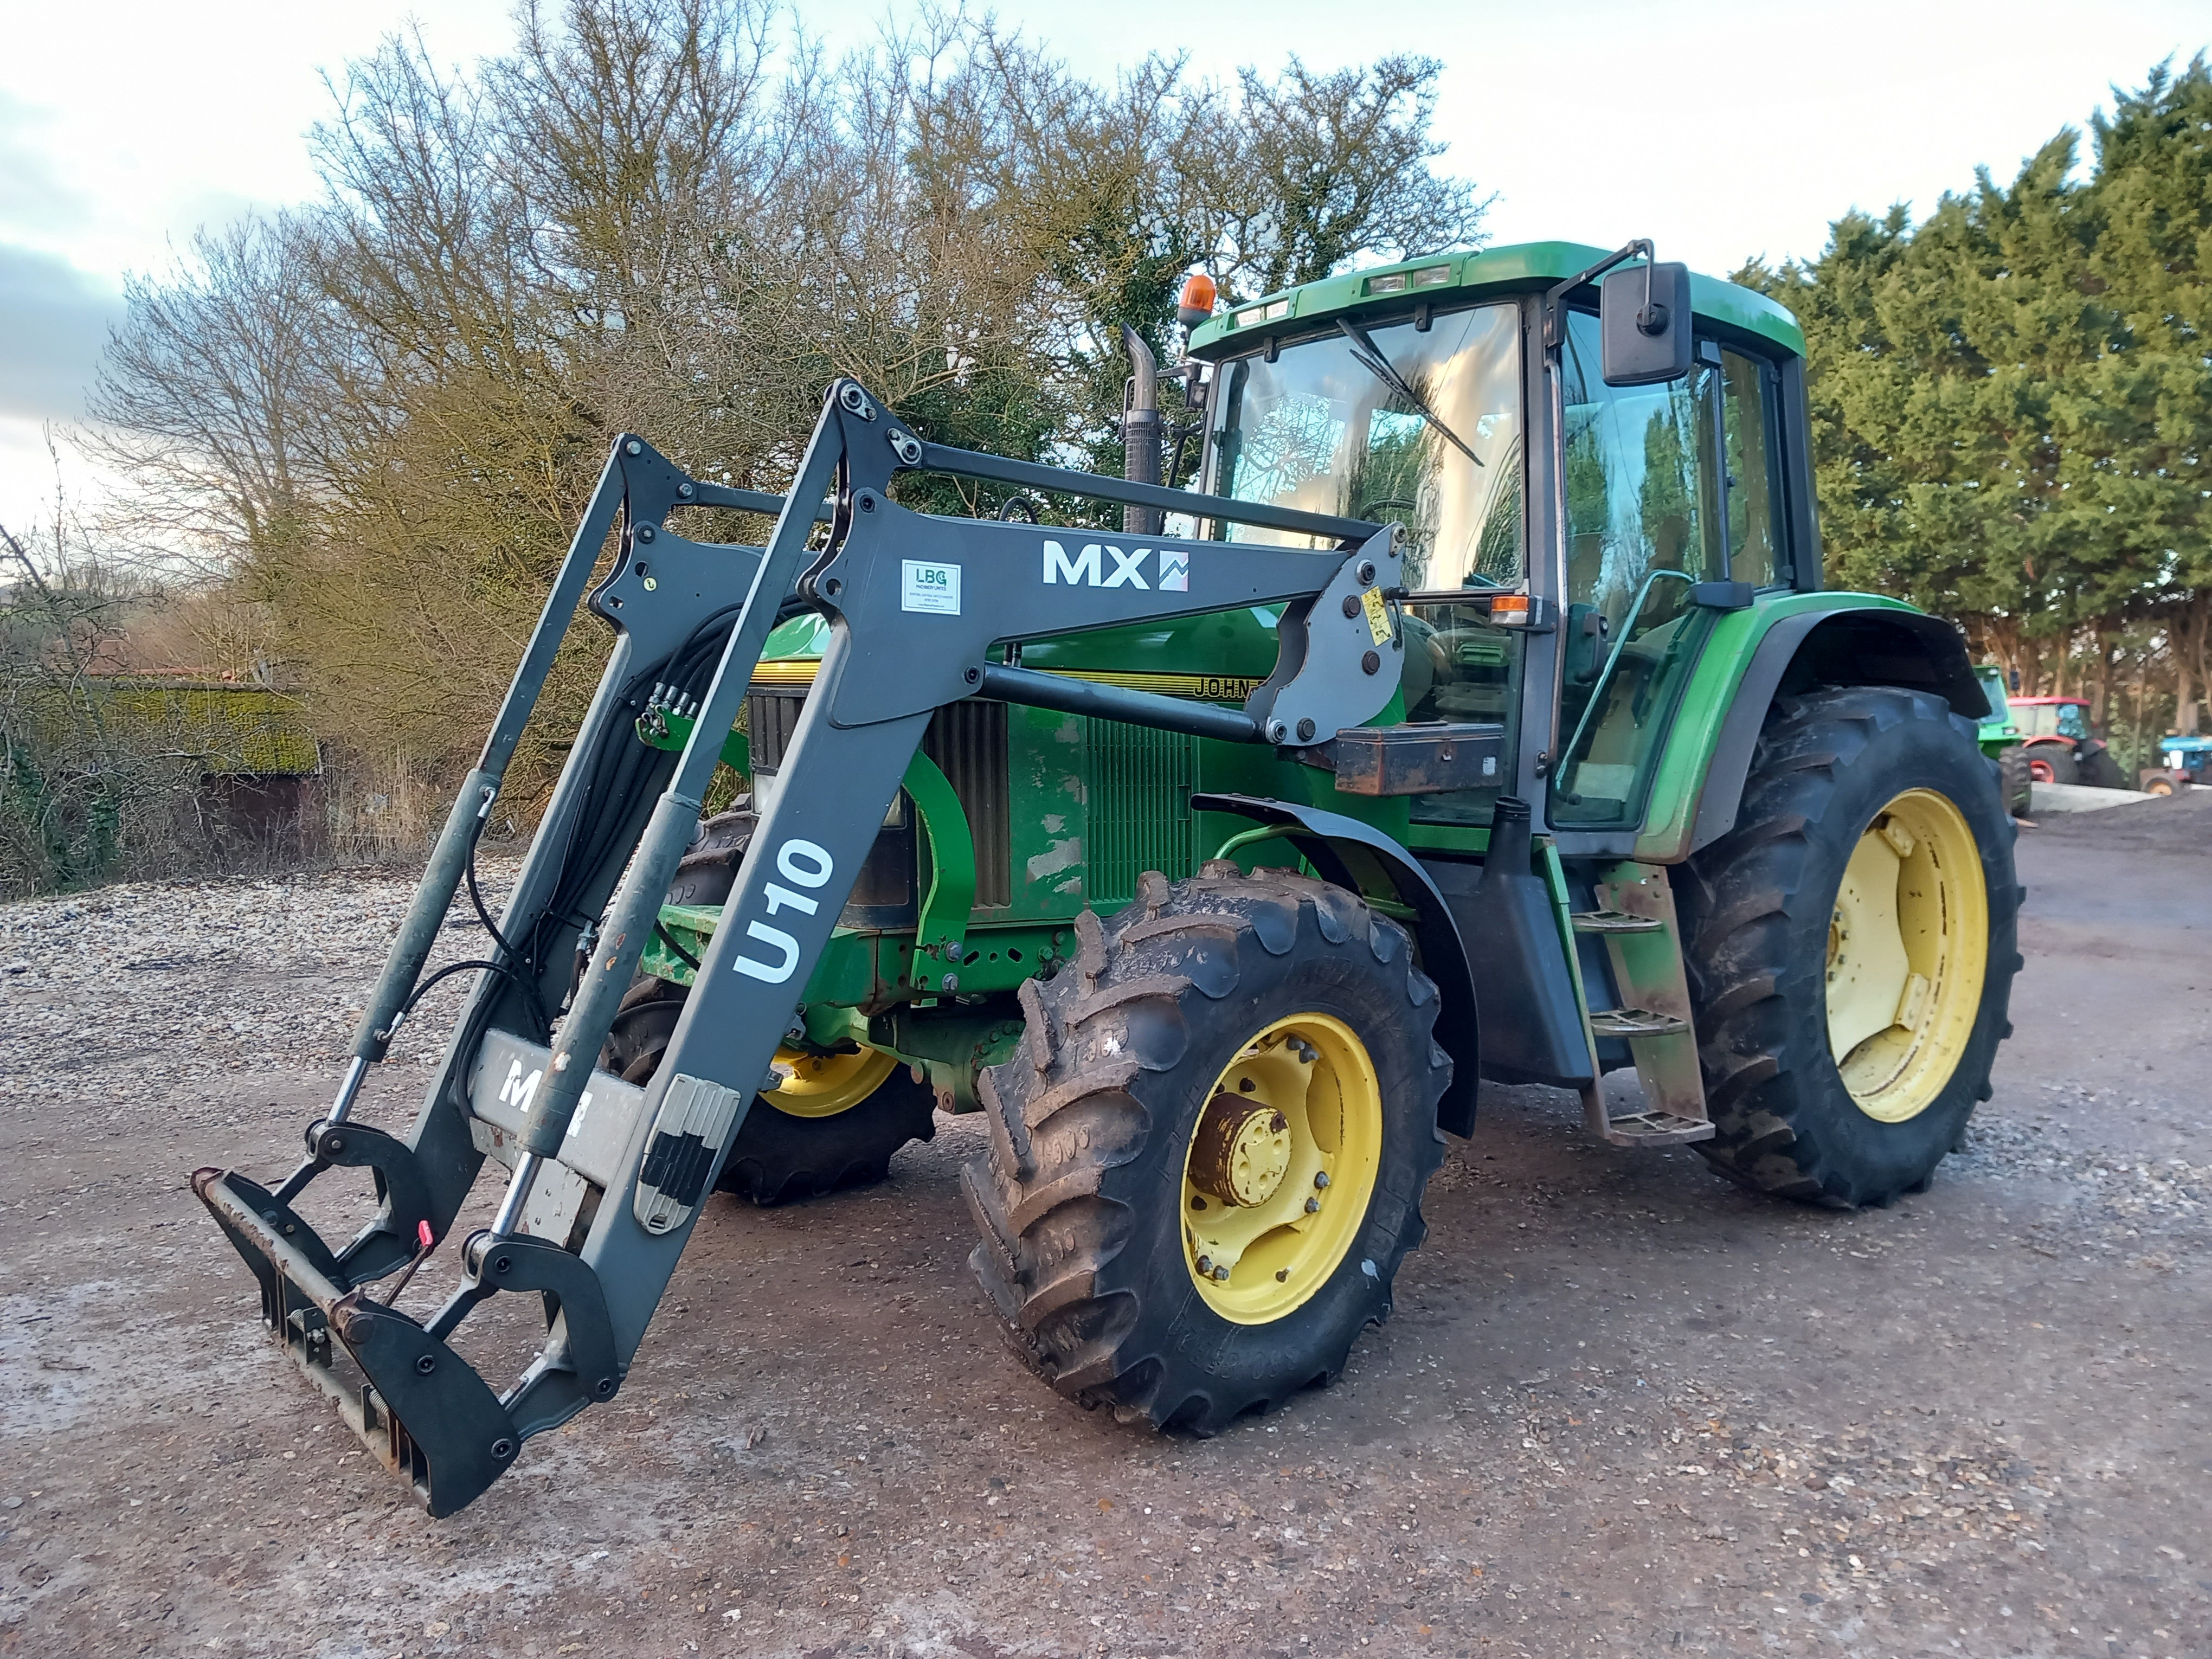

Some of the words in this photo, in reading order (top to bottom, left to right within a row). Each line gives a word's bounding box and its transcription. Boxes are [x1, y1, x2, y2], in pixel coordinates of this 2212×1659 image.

[916, 568, 947, 587] LBG
[1043, 540, 1153, 590] MX
[1194, 678, 1249, 697] JOHN
[498, 1059, 543, 1114] M
